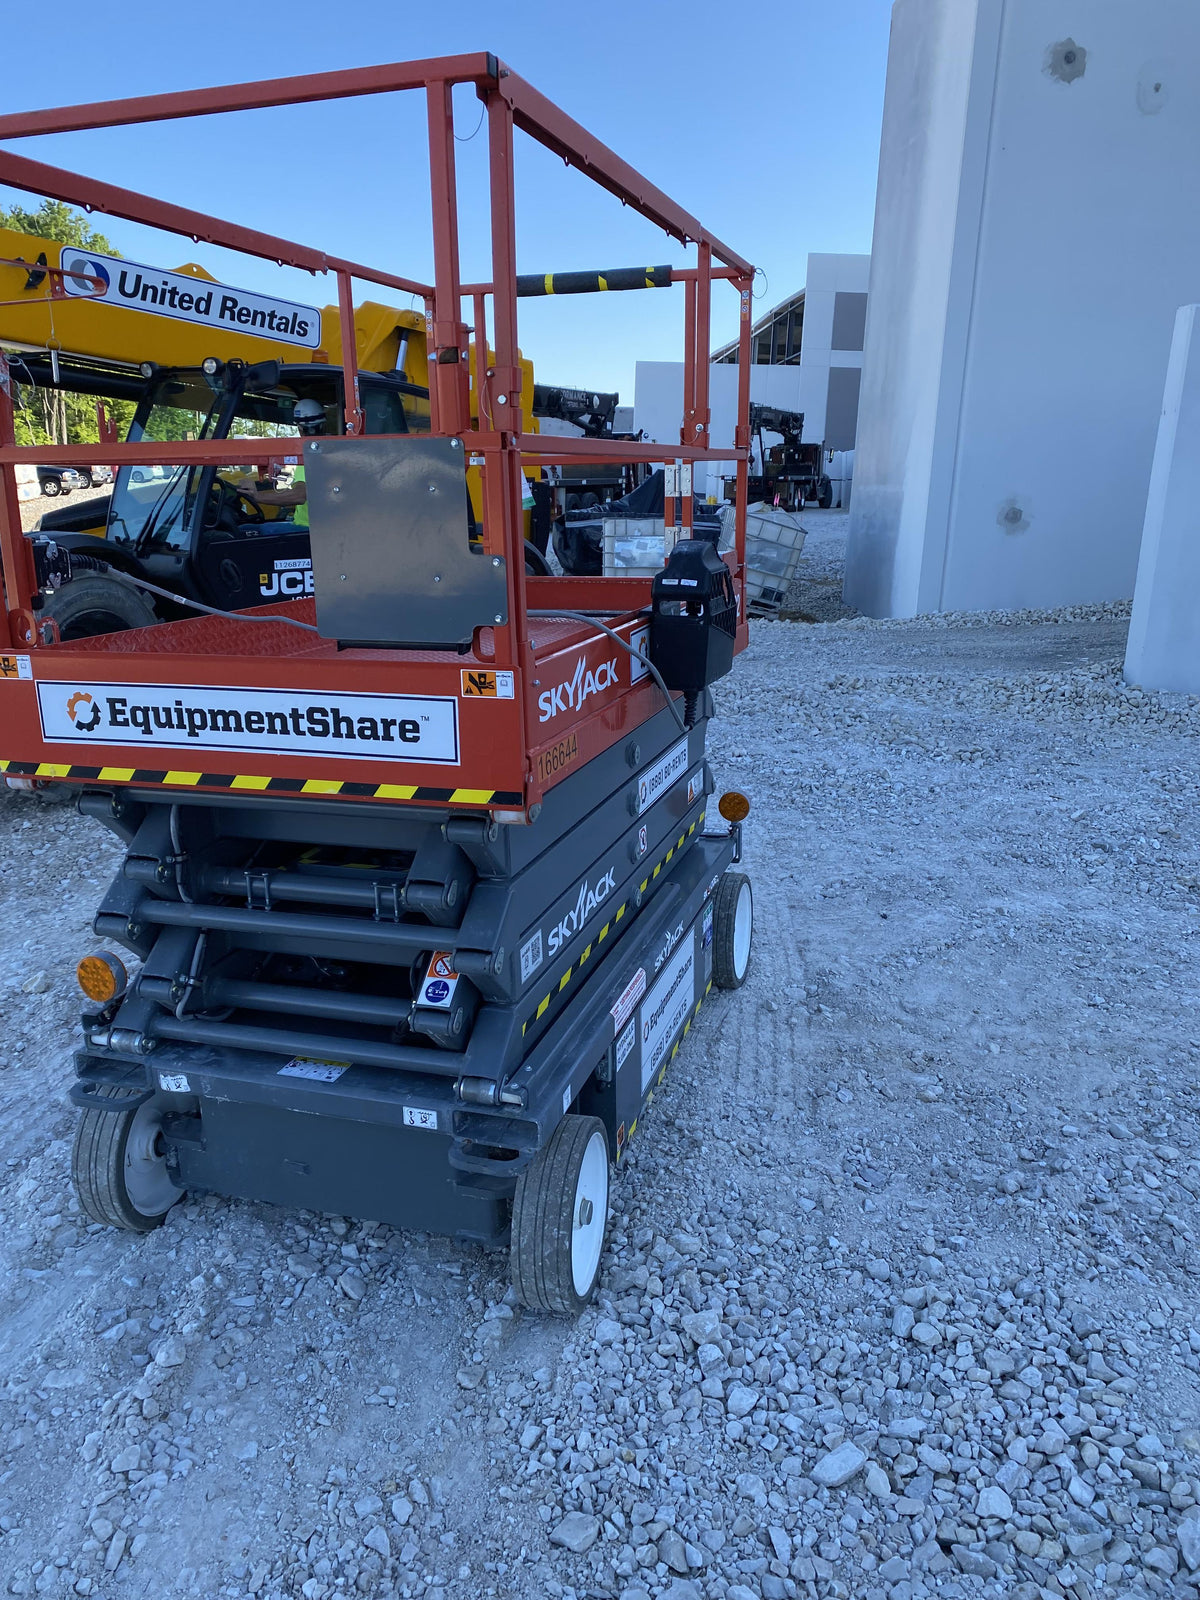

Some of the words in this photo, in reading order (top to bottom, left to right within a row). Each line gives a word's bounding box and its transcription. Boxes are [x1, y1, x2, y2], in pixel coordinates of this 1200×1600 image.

[118, 270, 214, 315] United
[218, 294, 309, 338] Rentals
[538, 654, 619, 723] SKYJACK
[538, 734, 578, 779] 166644
[547, 866, 616, 957] SKYJACK
[654, 919, 684, 973] SKYJACK
[650, 954, 692, 1032] EquipmentShare
